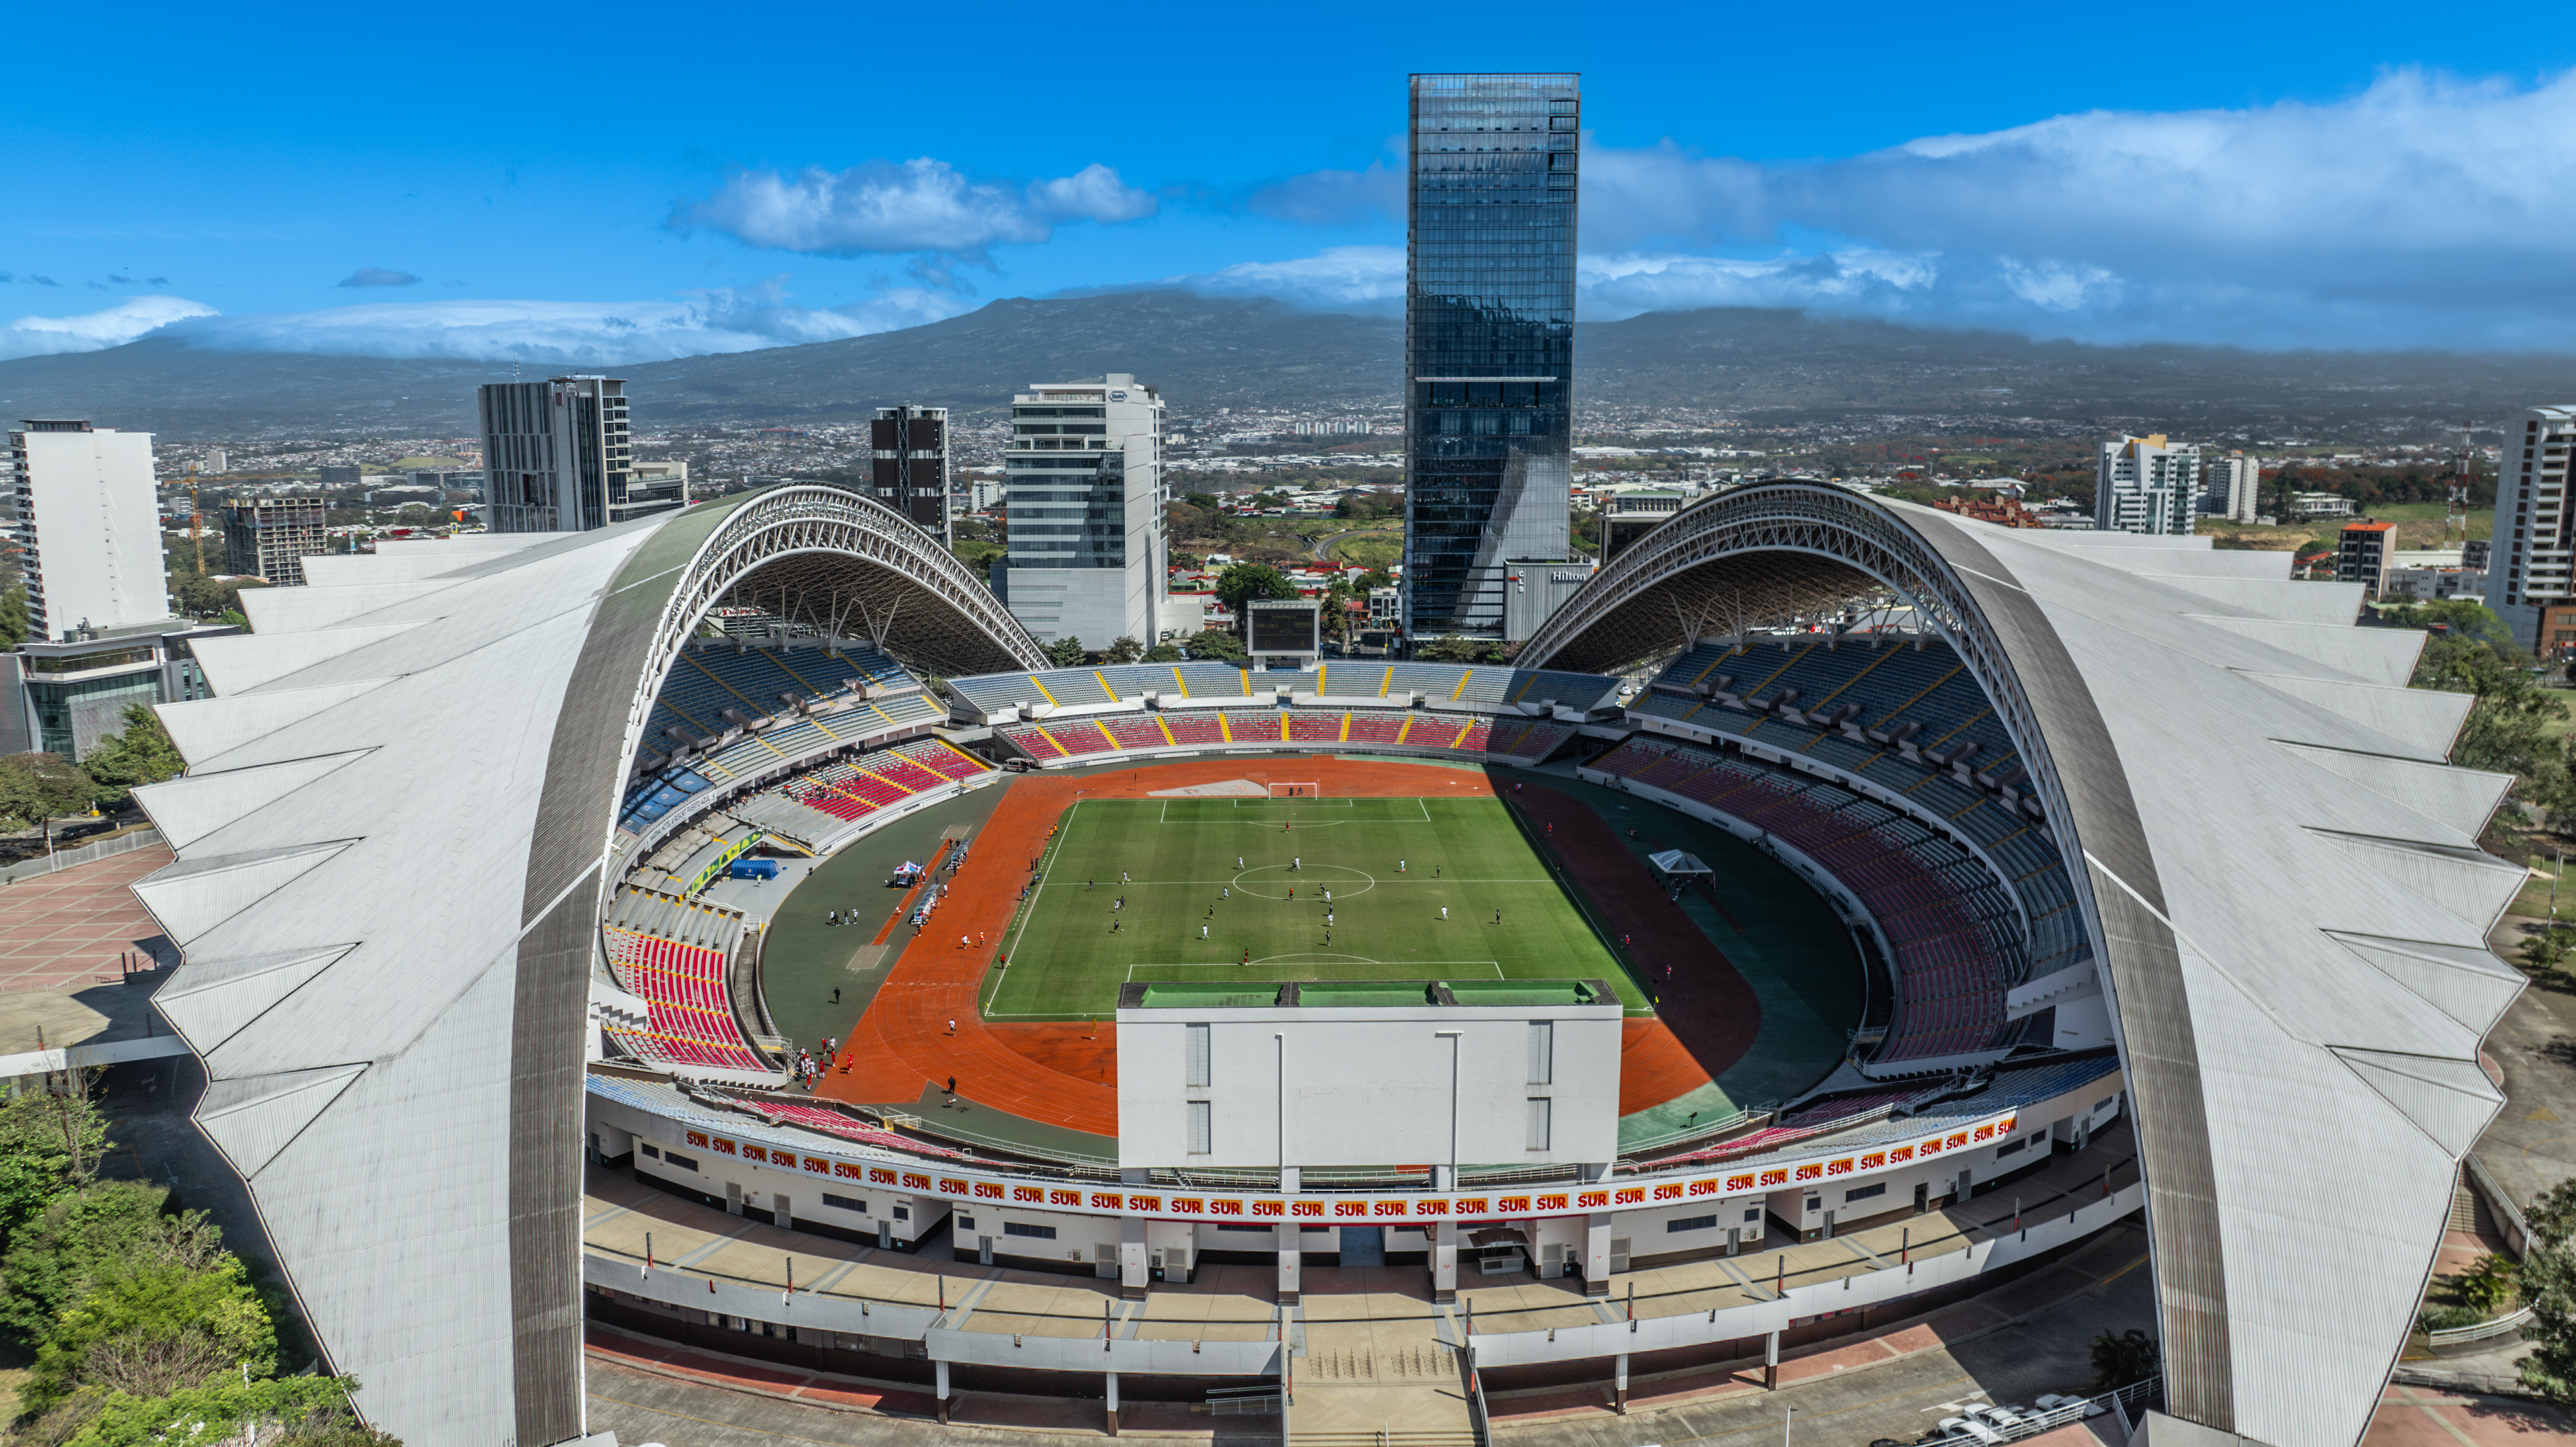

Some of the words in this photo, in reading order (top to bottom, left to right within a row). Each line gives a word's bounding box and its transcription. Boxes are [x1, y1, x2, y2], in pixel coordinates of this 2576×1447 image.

[1553, 571, 1586, 581] Hilton
[650, 828, 661, 842] MARINA
[662, 819, 671, 832] HOTEL
[674, 808, 687, 822] RESORT
[687, 800, 701, 813] PUERTO
[701, 794, 710, 806] AZUL
[687, 1132, 708, 1149] SUR
[712, 1139, 735, 1155] SUR
[743, 1146, 766, 1162] SUR
[772, 1152, 795, 1169] SUR
[803, 1158, 829, 1175] SUR
[834, 1164, 861, 1180] SUR
[869, 1170, 897, 1186] SUR
[902, 1175, 930, 1190] SUR
[940, 1180, 967, 1195] SUR
[974, 1185, 1003, 1199] SUR
[1013, 1188, 1042, 1203] SUR
[1050, 1192, 1079, 1206] SUR
[1091, 1195, 1122, 1209] SUR
[1129, 1197, 1159, 1212] SUR
[1171, 1200, 1202, 1213] SUR
[1210, 1201, 1241, 1215] SUR
[1252, 1203, 1283, 1216] SUR
[1291, 1203, 1322, 1216] SUR
[1334, 1203, 1366, 1216] SUR
[1374, 1203, 1405, 1216] SUR
[1417, 1202, 1447, 1215] SUR
[1456, 1200, 1486, 1214] SUR
[1498, 1198, 1528, 1212] SUR
[1537, 1196, 1567, 1210] SUR
[1578, 1193, 1607, 1208] SUR
[1615, 1190, 1643, 1204] SUR
[1653, 1186, 1681, 1200] SUR
[1689, 1181, 1716, 1196] SUR
[1726, 1176, 1753, 1191] SUR
[1760, 1171, 1786, 1186] SUR
[1796, 1166, 1821, 1181] SUR
[1827, 1160, 1852, 1175] SUR
[1861, 1154, 1884, 1170] SUR
[1890, 1148, 1912, 1164] SUR
[1920, 1141, 1941, 1156] SUR
[1946, 1134, 1967, 1149] SUR
[1974, 1127, 1994, 1142] SUR
[1998, 1118, 2017, 1135] SUR
